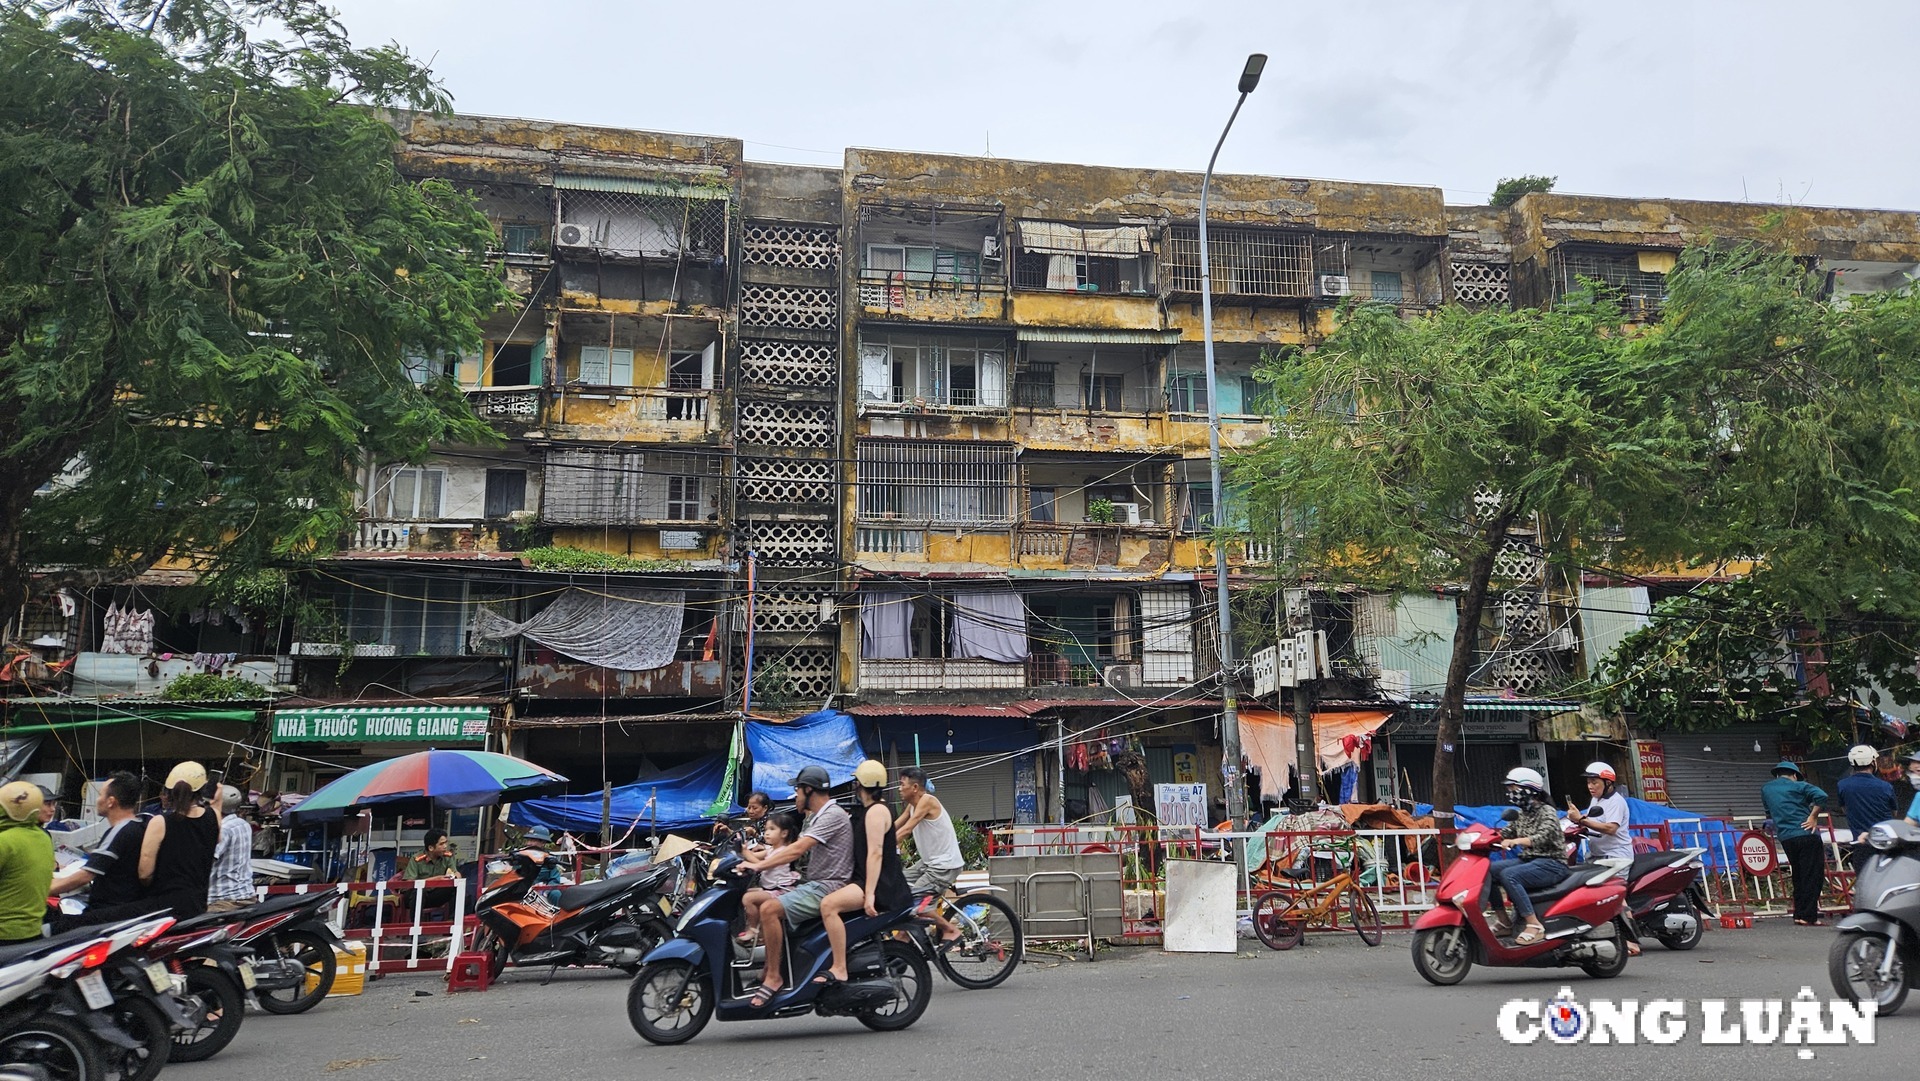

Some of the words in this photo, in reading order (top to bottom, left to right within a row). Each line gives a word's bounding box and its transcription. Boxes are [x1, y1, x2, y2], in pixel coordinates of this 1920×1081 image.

[277, 715, 306, 737] NHÀ
[314, 714, 357, 737] THUỐC
[365, 716, 412, 736] HƯƠNG
[417, 717, 459, 736] GIANG
[1179, 773, 1193, 782] Trà
[1192, 785, 1203, 795] A7
[1161, 795, 1187, 826] BÚN
